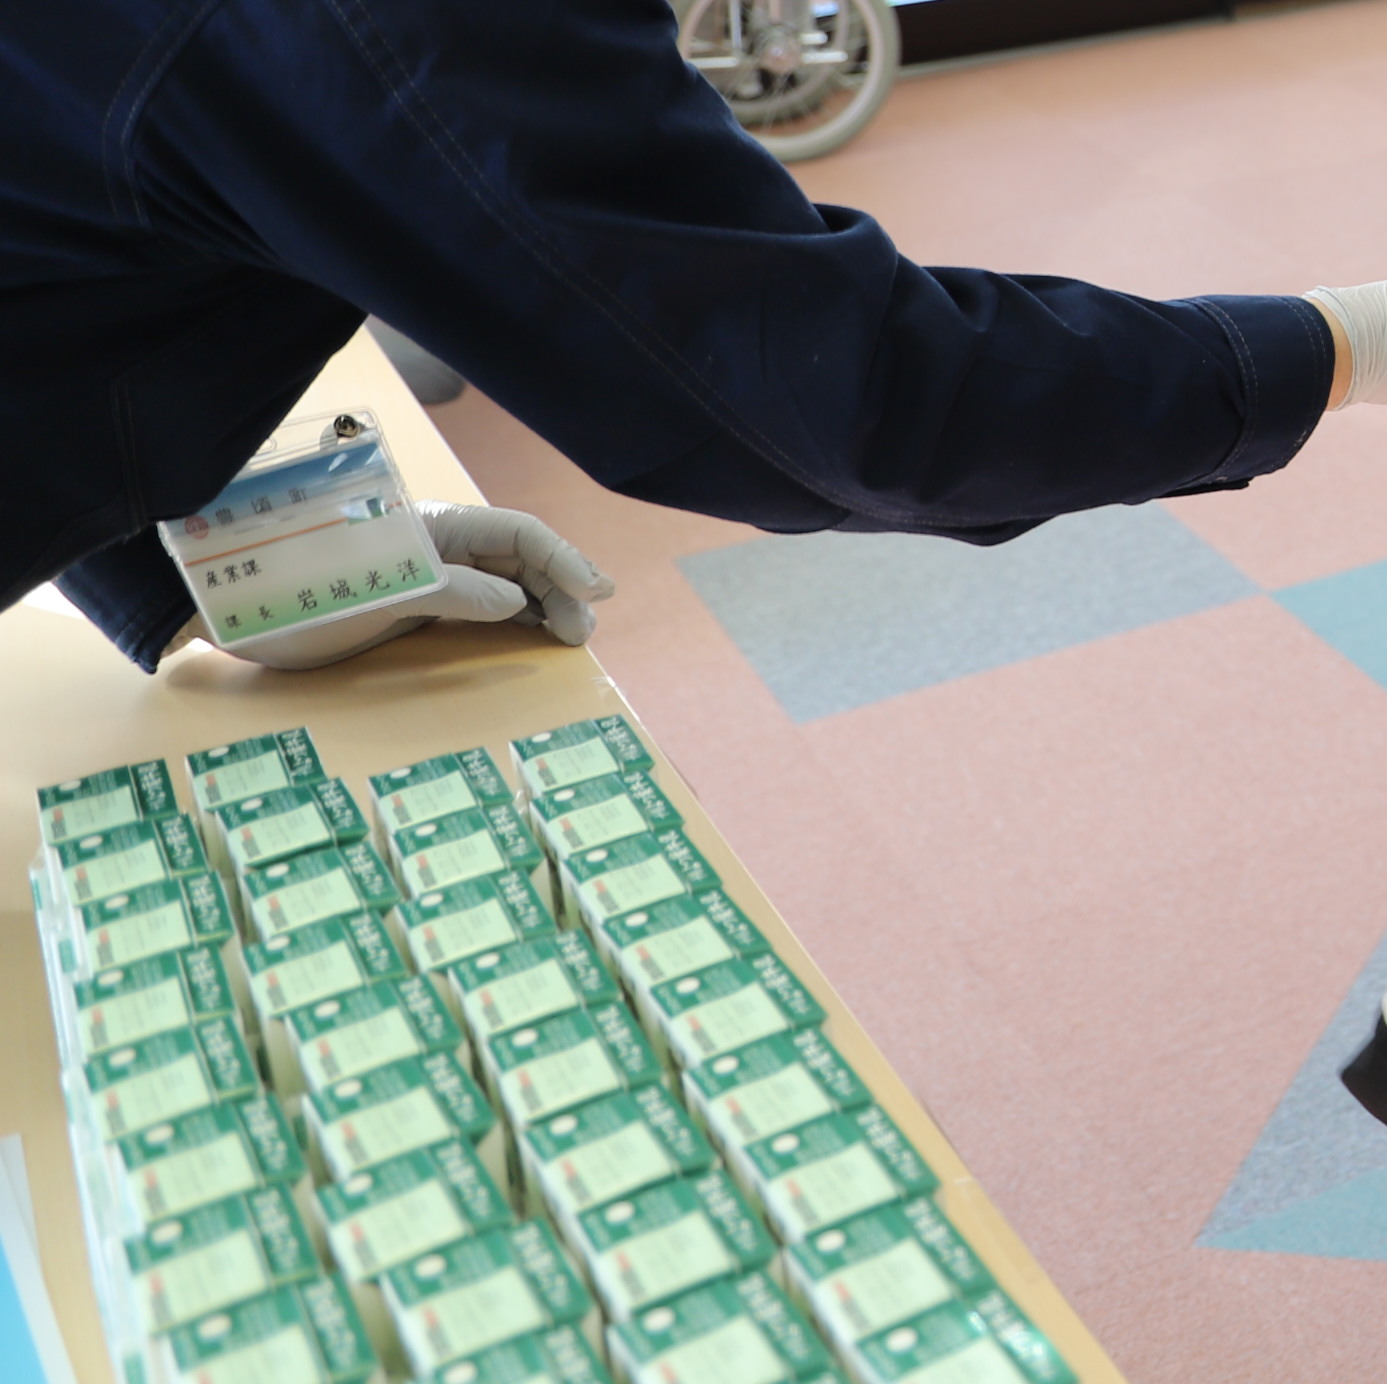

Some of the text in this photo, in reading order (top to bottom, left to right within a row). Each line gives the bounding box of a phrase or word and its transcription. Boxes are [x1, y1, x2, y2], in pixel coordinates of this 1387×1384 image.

[205, 558, 263, 590] 産業課
[224, 557, 421, 630] 課長 岩城光洋
